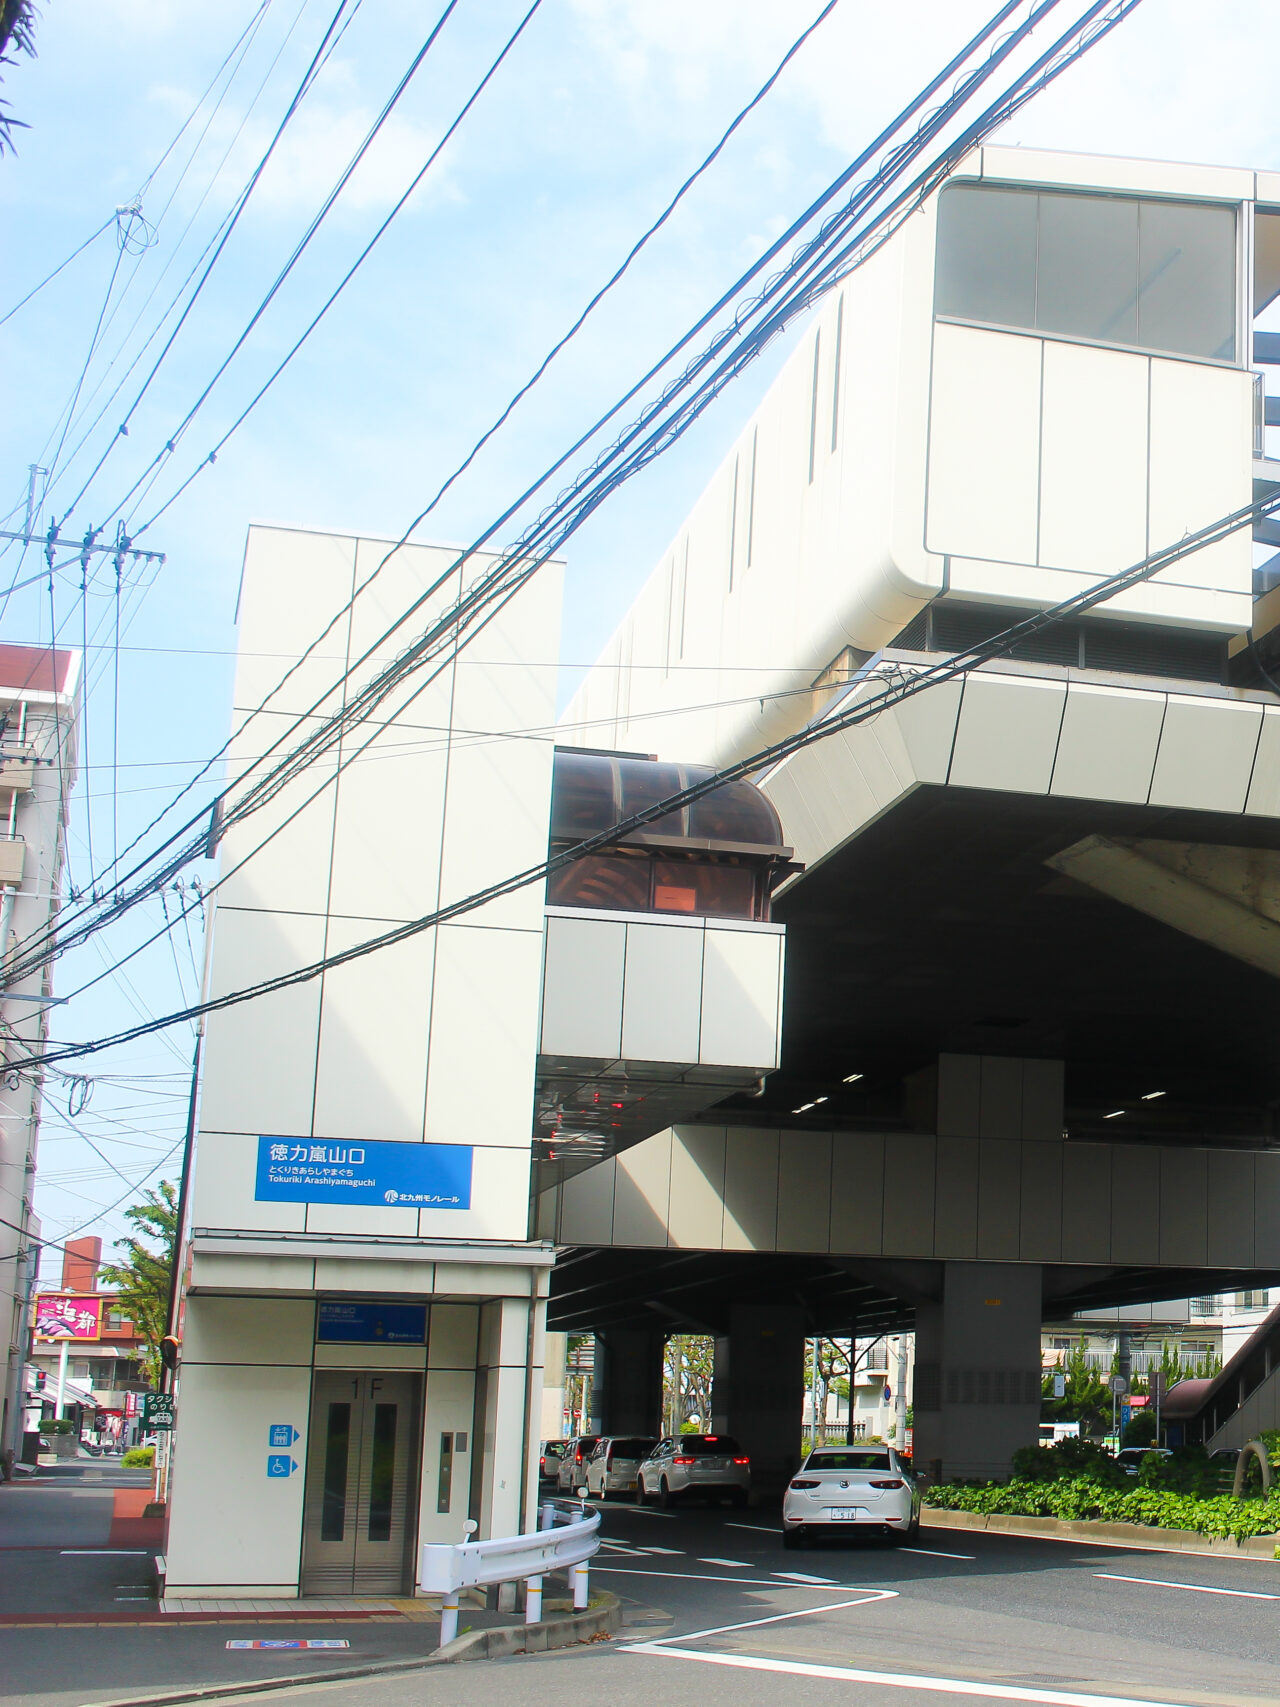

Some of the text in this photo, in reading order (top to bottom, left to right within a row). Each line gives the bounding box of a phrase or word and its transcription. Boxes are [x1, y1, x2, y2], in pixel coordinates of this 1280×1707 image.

[270, 1143, 365, 1165] 徳力嵐山口
[269, 1165, 354, 1177] とくりきあらしやまぐち
[268, 1174, 376, 1188] Tokuriki Arashiyamaguchi
[399, 1193, 460, 1204] 北九州モノレール
[147, 1395, 173, 1403] タクシ
